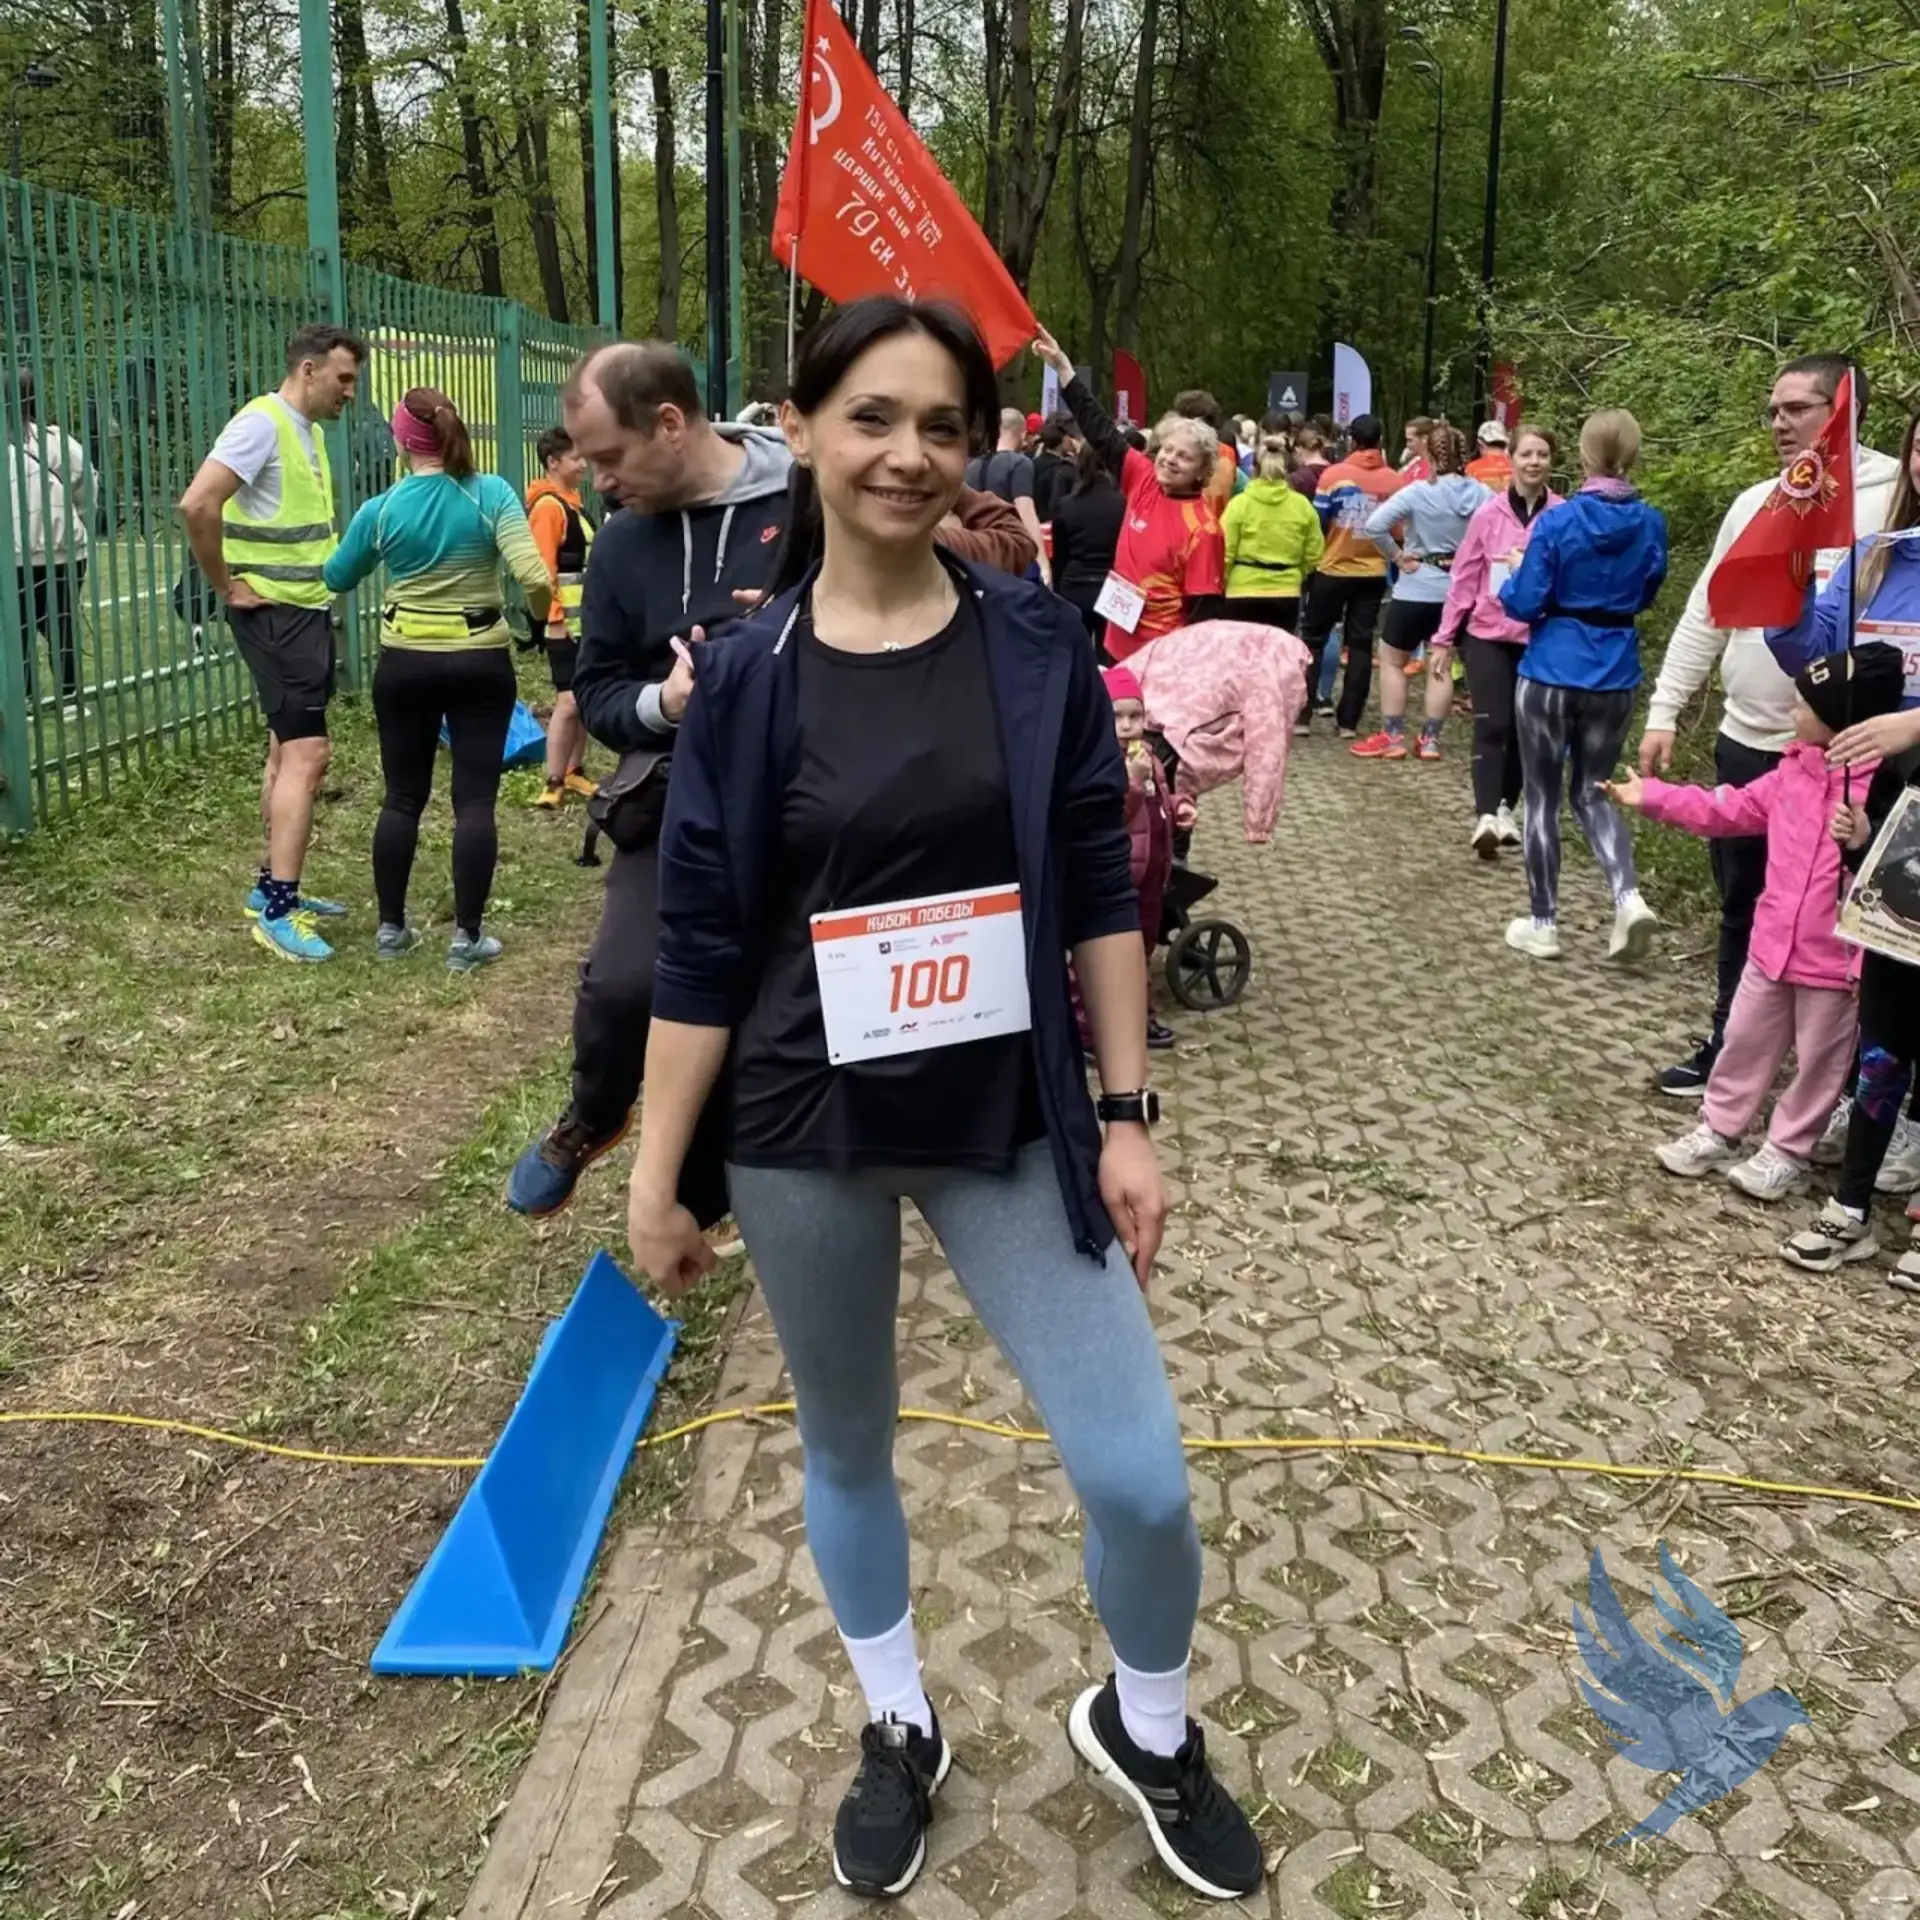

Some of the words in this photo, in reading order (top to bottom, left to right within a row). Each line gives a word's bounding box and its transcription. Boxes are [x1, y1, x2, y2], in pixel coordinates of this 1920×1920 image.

[835, 189, 880, 237] 79
[866, 911, 913, 933] КУБОК
[917, 901, 976, 925] ПОБЕДЫ
[889, 954, 970, 1013] 100
